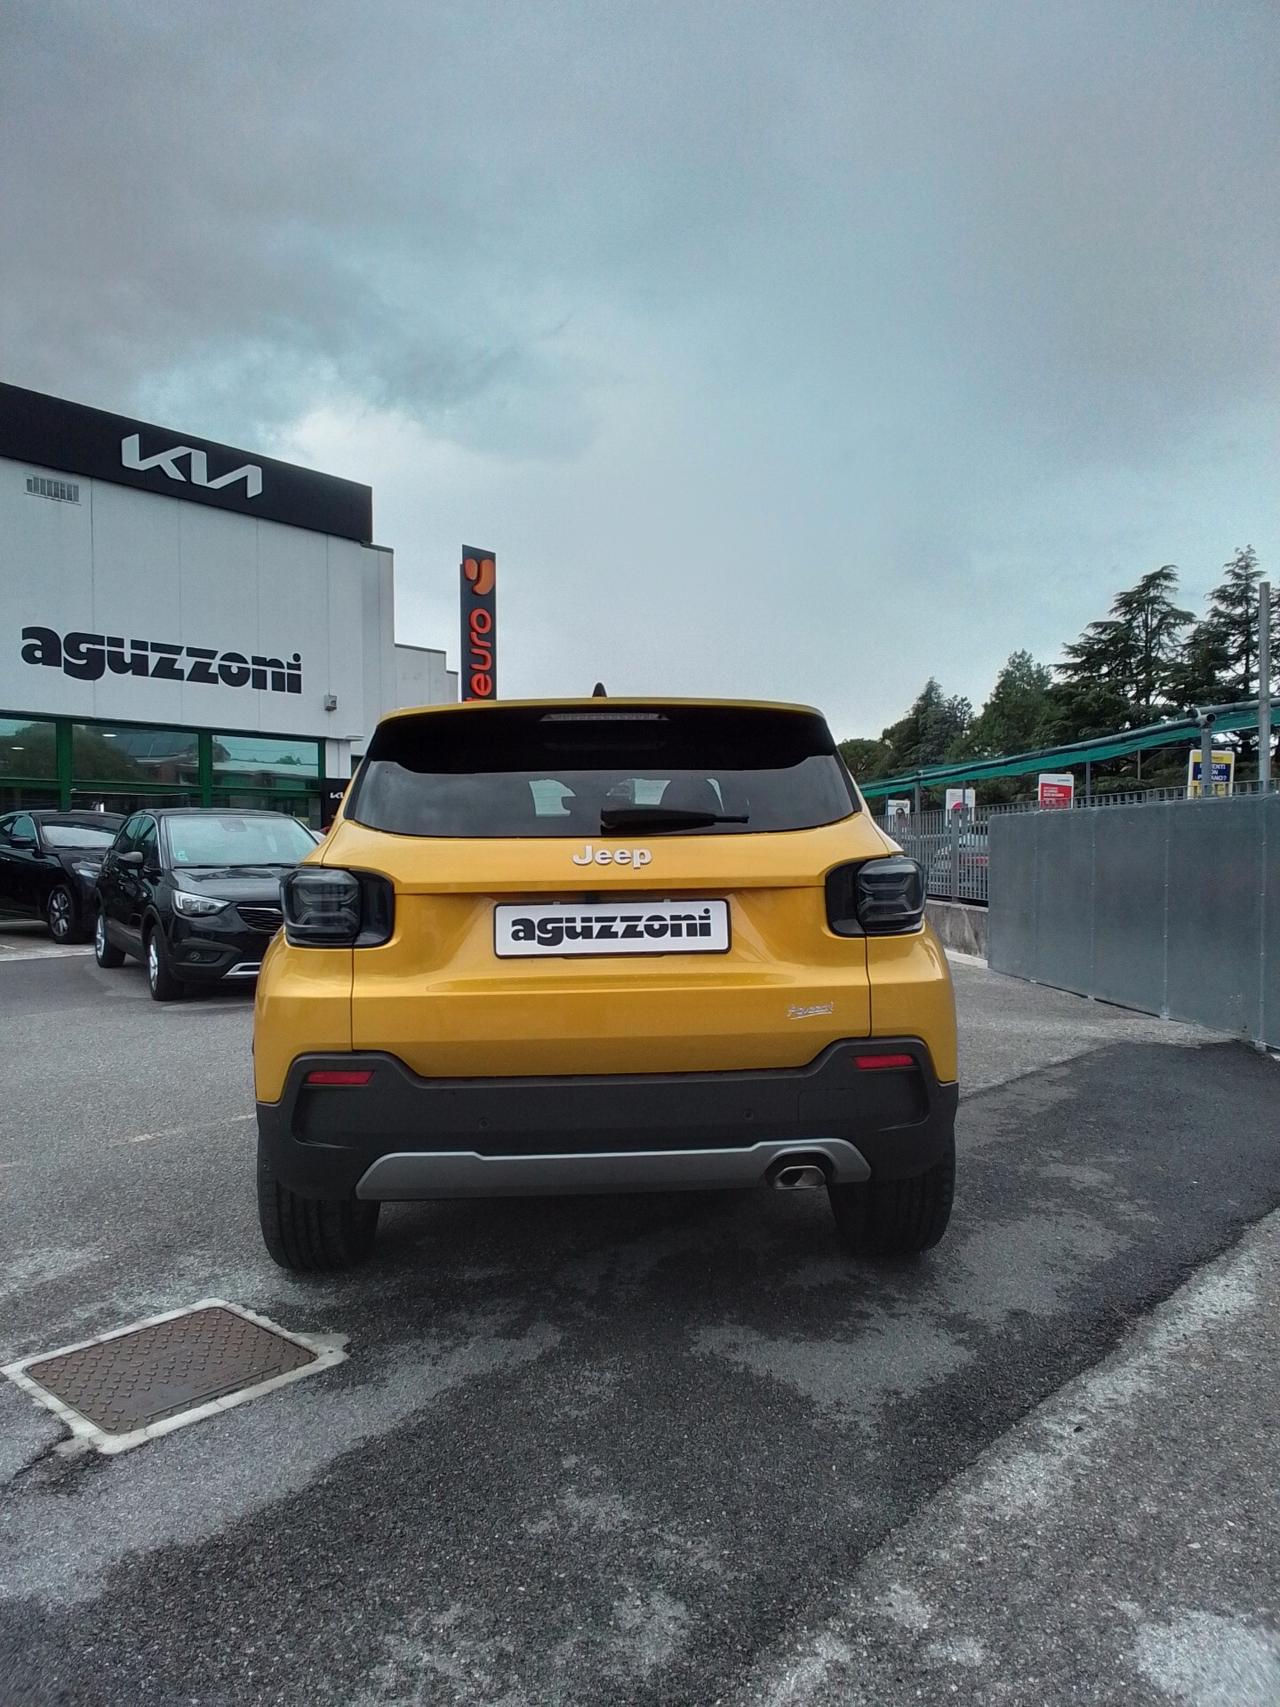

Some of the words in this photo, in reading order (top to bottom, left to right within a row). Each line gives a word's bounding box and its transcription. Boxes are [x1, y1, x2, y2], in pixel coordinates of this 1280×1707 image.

[121, 433, 263, 499] KIA
[21, 626, 302, 694] aguzzoni
[572, 845, 653, 869] Jeep
[511, 907, 711, 947] aguzzoni
